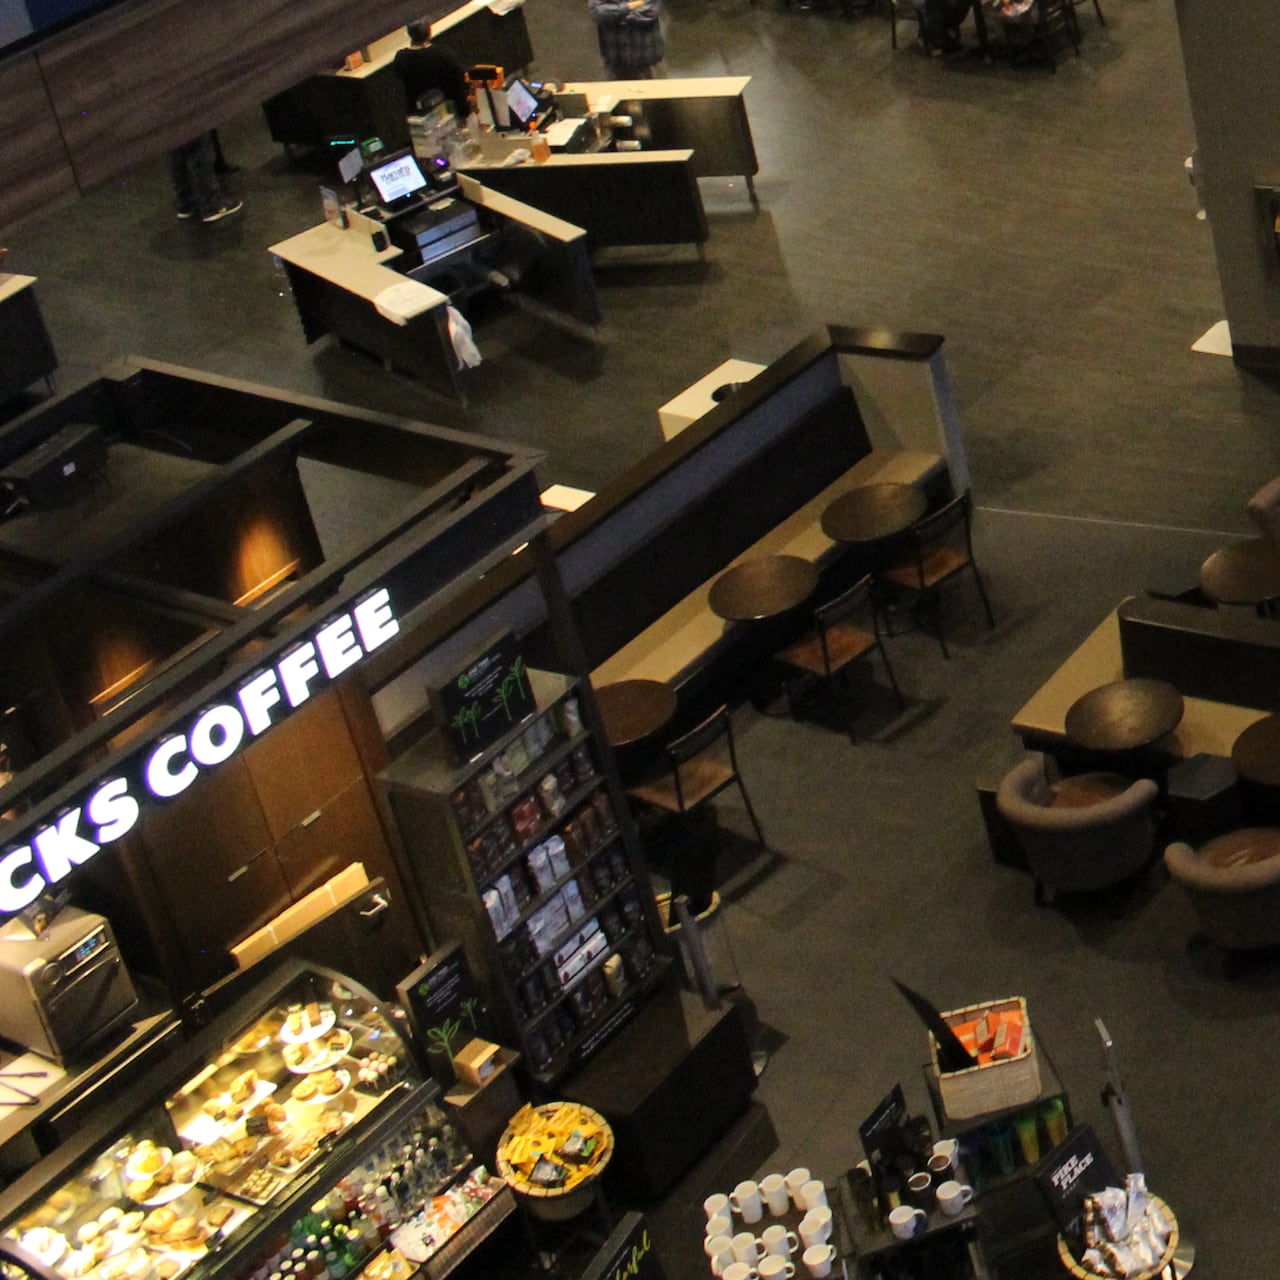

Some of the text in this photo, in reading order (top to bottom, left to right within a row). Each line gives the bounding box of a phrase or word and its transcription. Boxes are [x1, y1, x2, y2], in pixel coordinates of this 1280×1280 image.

[143, 587, 400, 798] COFFEE
[1051, 1154, 1079, 1187] PIKE
[1060, 1151, 1094, 1190] PLACE
